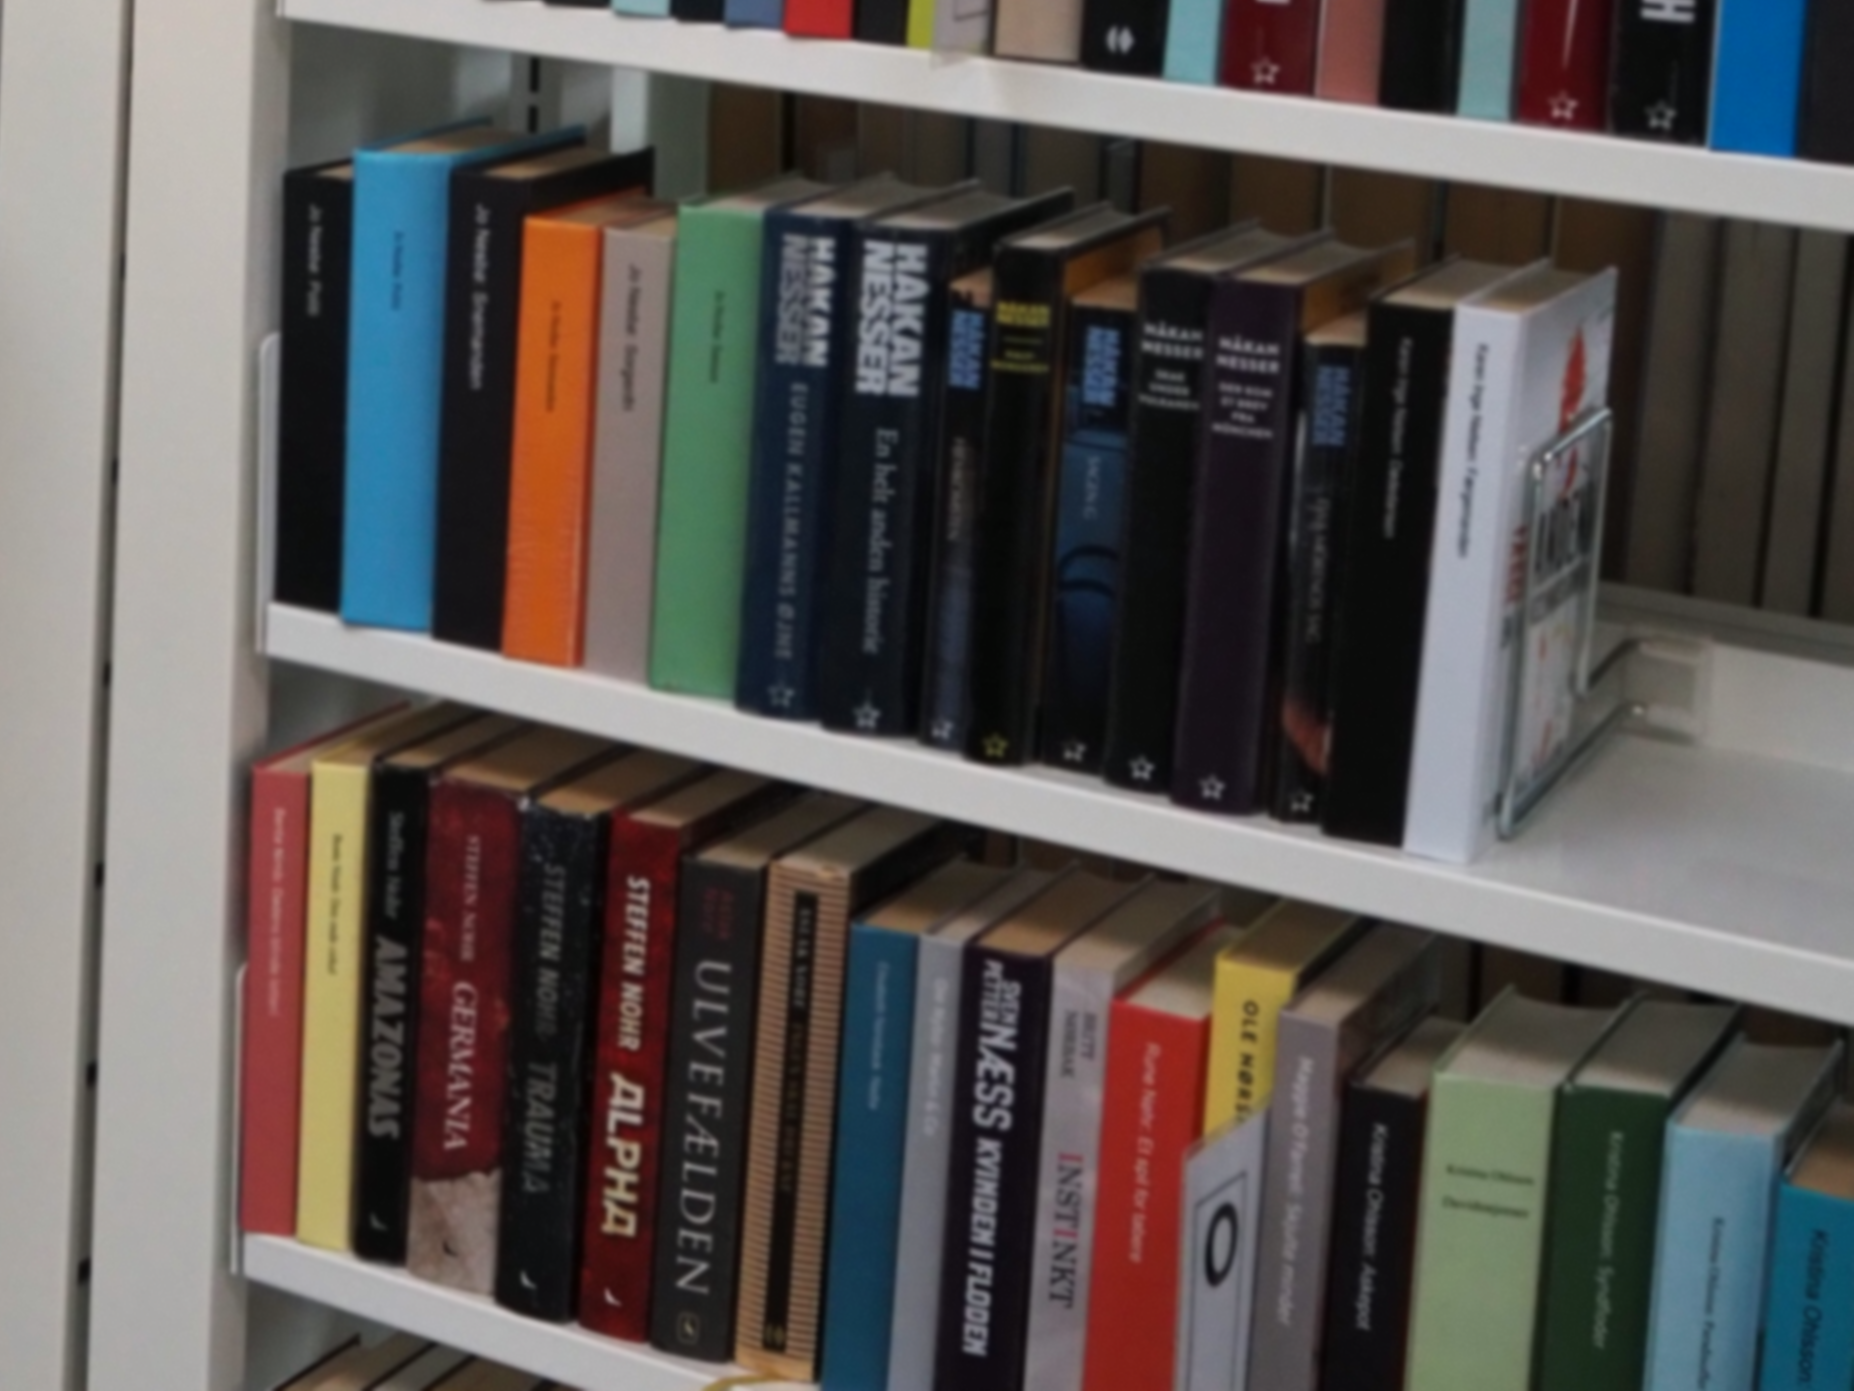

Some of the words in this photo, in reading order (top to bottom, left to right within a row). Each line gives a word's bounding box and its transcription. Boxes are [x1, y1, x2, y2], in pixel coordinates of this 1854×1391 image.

[474, 203, 492, 224] Jo
[775, 233, 808, 366] NESSER
[805, 236, 836, 368] HÅKAN
[855, 238, 894, 395] NESSER
[888, 240, 930, 397] HÅKAN
[1143, 320, 1204, 342] HÅKAN
[1141, 340, 1204, 359] NESSER
[1216, 353, 1280, 374] NESSER
[1219, 334, 1280, 356] HÅKAN
[786, 381, 809, 456] EUGEN
[875, 427, 899, 459] En
[871, 461, 895, 504] helt
[776, 463, 804, 597] KALLMANNS
[868, 508, 891, 572] anden
[773, 602, 797, 660] ØJNE
[863, 575, 887, 655] historie
[460, 833, 482, 906] STEFFEN
[537, 863, 568, 961] STEFFEN
[619, 874, 654, 973] STEFFEN
[615, 978, 646, 1052] NOHR
[980, 959, 1002, 1022] PETTER
[1000, 979, 1021, 1024] SVEN
[1239, 999, 1260, 1045] OLE
[367, 935, 409, 1139] AMAZONAS
[442, 979, 483, 1151] GERMANIA
[1077, 1011, 1098, 1061] BRITT
[972, 1024, 1019, 1132] NÆSS
[521, 1059, 560, 1194] TRAUMA
[600, 1069, 647, 1239] ALPHA
[673, 958, 735, 1296] ULVEFÆLDEN
[1366, 1122, 1388, 1184] Kristina
[1603, 1130, 1626, 1190] Kristina
[970, 1137, 1001, 1245] KVINDEN
[1600, 1194, 1623, 1258] Ohlsson:
[968, 1248, 991, 1258] I
[1048, 1150, 1084, 1309] INSTINKT
[1204, 1200, 1239, 1289] O
[1803, 1228, 1830, 1300] Kristina
[960, 1262, 991, 1357] FLODEN
[1351, 1261, 1377, 1331] Askepot
